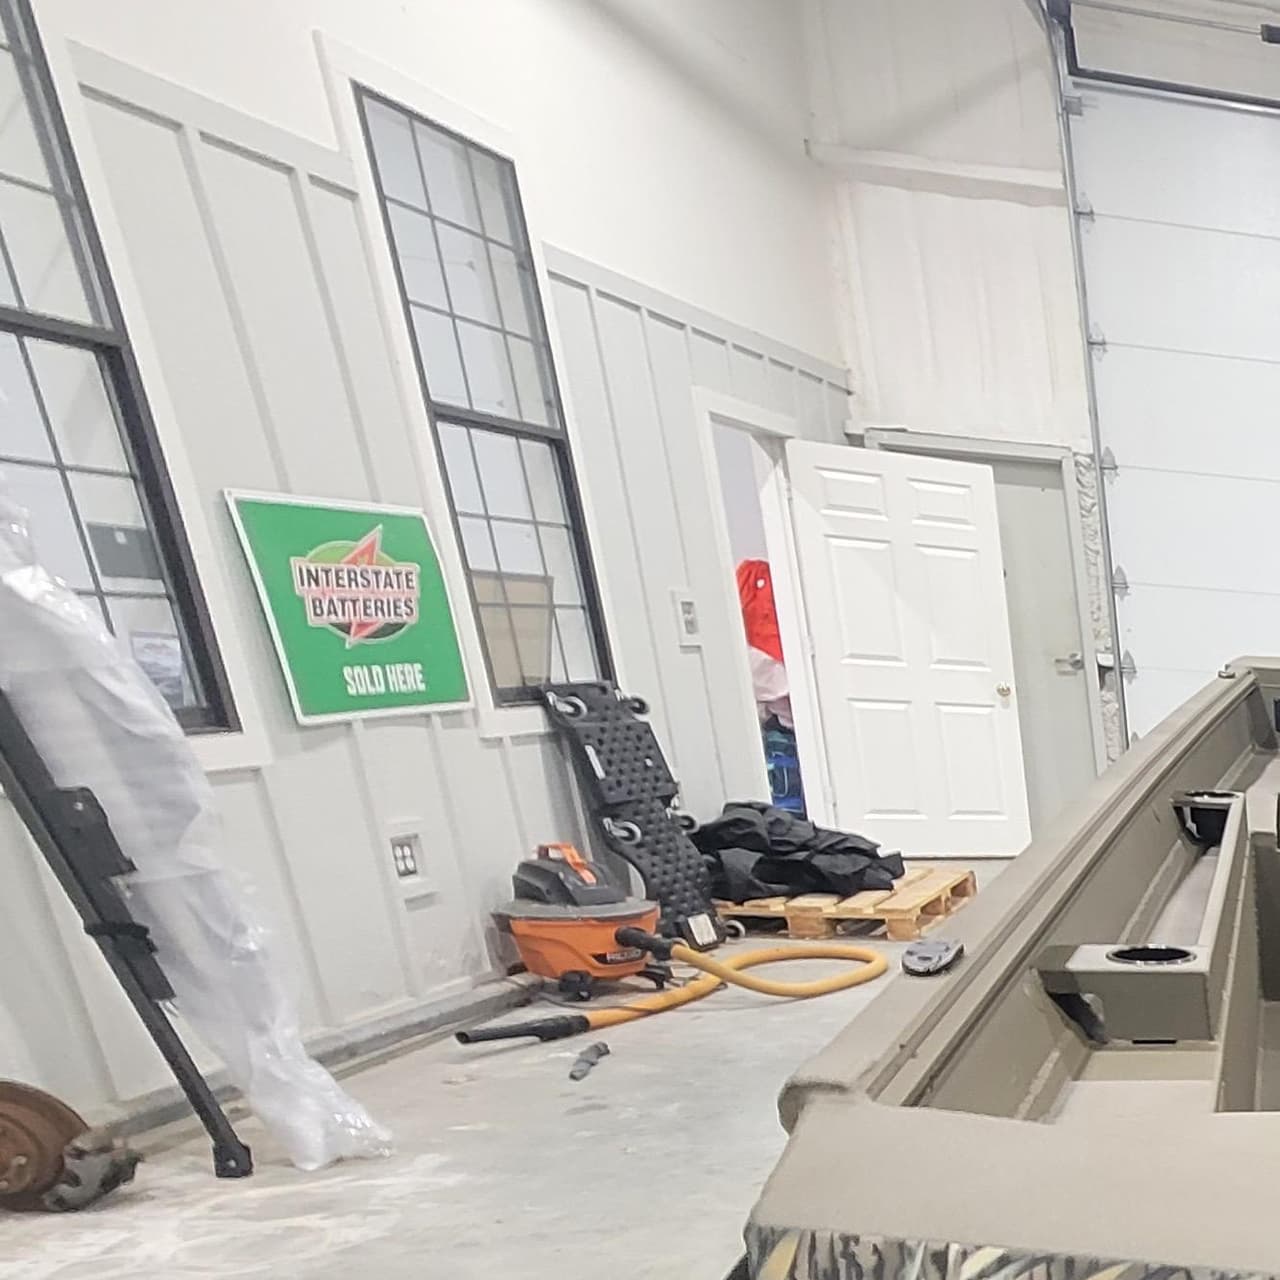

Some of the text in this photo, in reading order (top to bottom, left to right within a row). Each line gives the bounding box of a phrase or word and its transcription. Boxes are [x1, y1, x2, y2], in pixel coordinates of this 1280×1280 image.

[299, 566, 415, 590] INTERSTATE
[312, 597, 414, 618] BATTERIES
[343, 662, 426, 696] SOLD HERE
